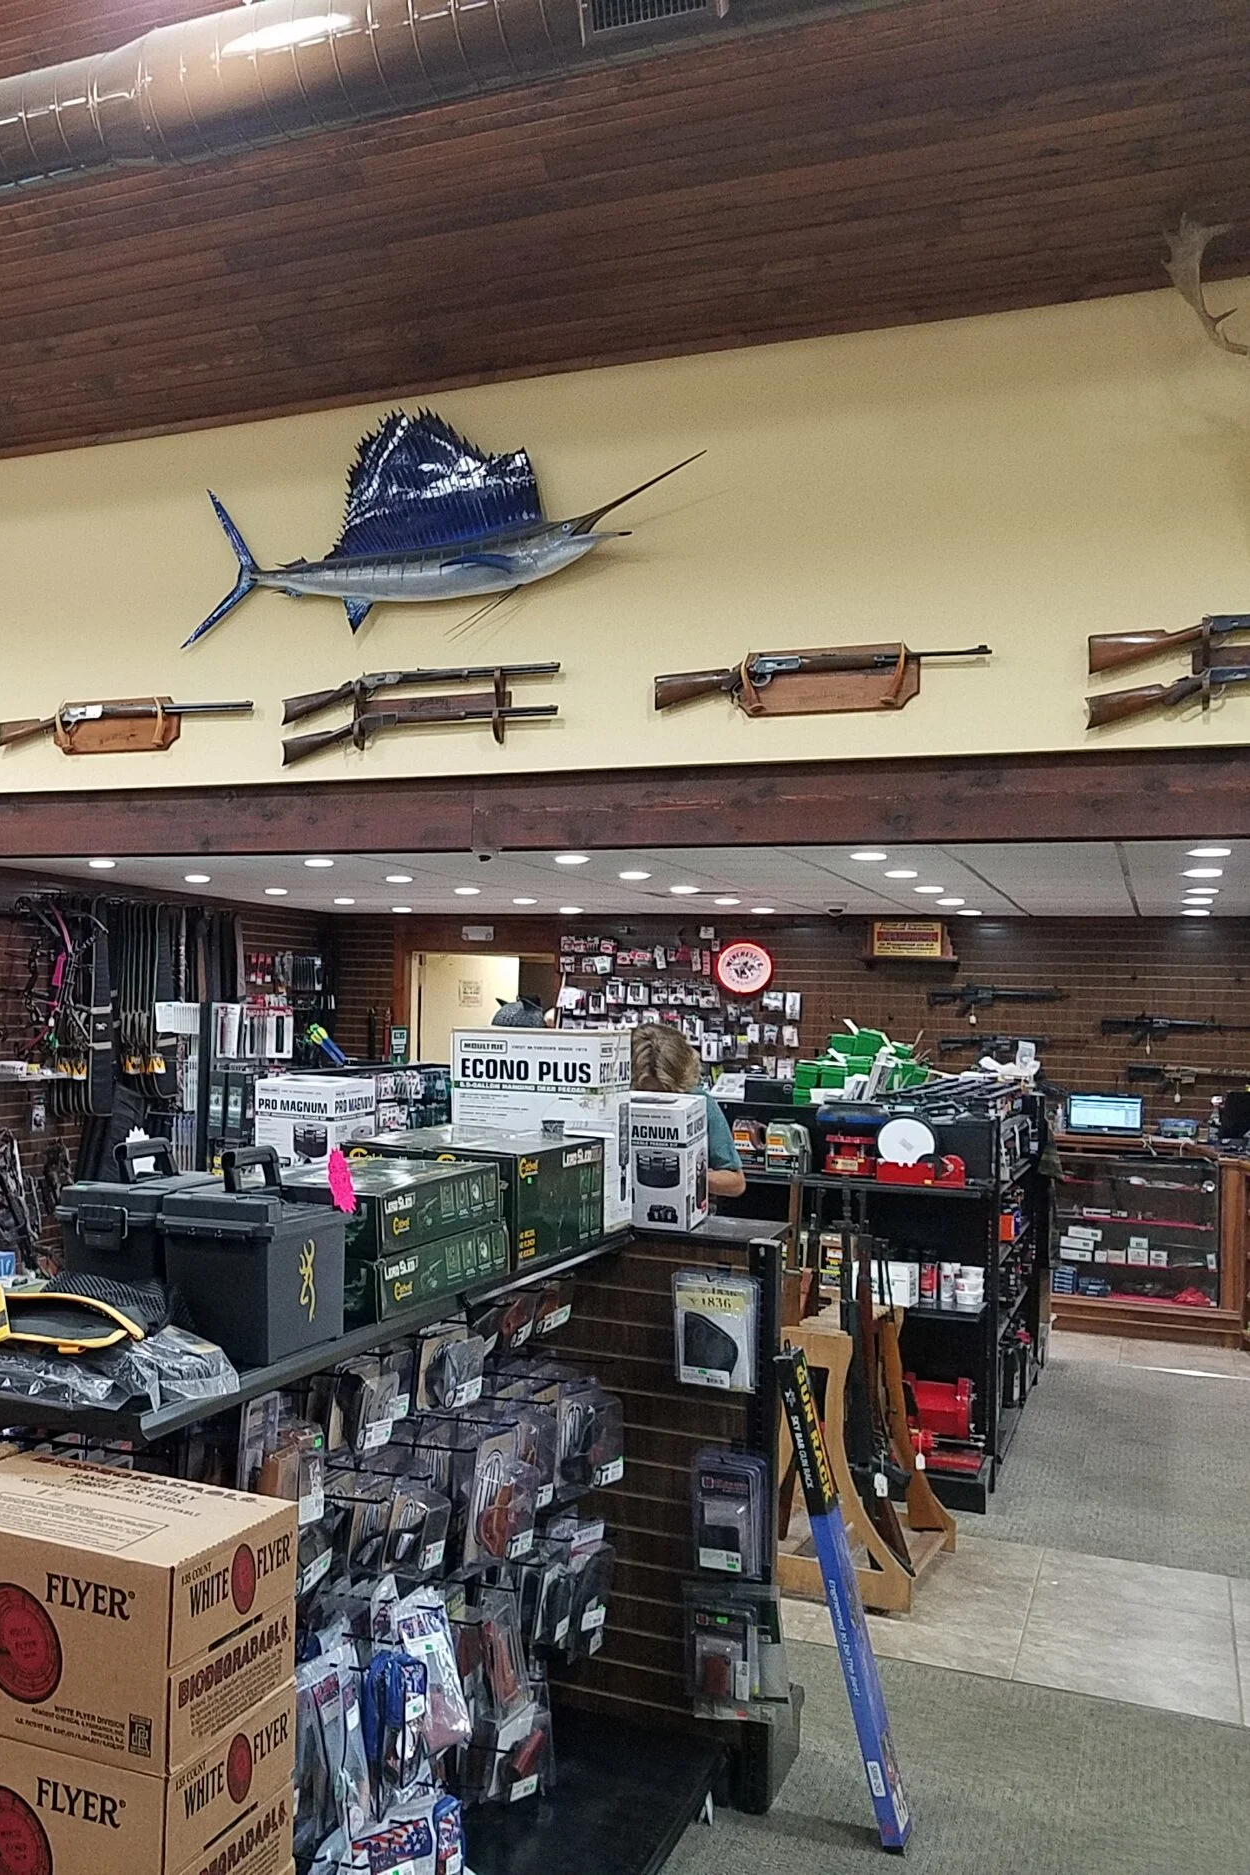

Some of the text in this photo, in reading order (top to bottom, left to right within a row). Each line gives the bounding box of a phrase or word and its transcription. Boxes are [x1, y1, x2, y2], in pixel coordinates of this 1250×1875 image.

[461, 1058, 591, 1083] ECONO PLUS
[258, 1098, 327, 1114] PRO MAGNUM
[632, 1125, 679, 1140] AGNUM
[702, 1297, 732, 1308] 1836
[791, 1415, 814, 1489] SKY BAR GUN RACK
[796, 1365, 832, 1504] GUN RACK
[189, 1533, 291, 1618] WHITE FLYER
[192, 1561, 212, 1580] COUNT
[45, 1572, 130, 1621] FLYER
[178, 1615, 287, 1710] BIODEGRADABLE
[54, 1705, 125, 1729] WHITE FLYER DIVISION
[184, 1712, 288, 1820] WHITE FLYER
[36, 1776, 121, 1829] FLYER
[199, 1800, 287, 1875] EGRADABLE
